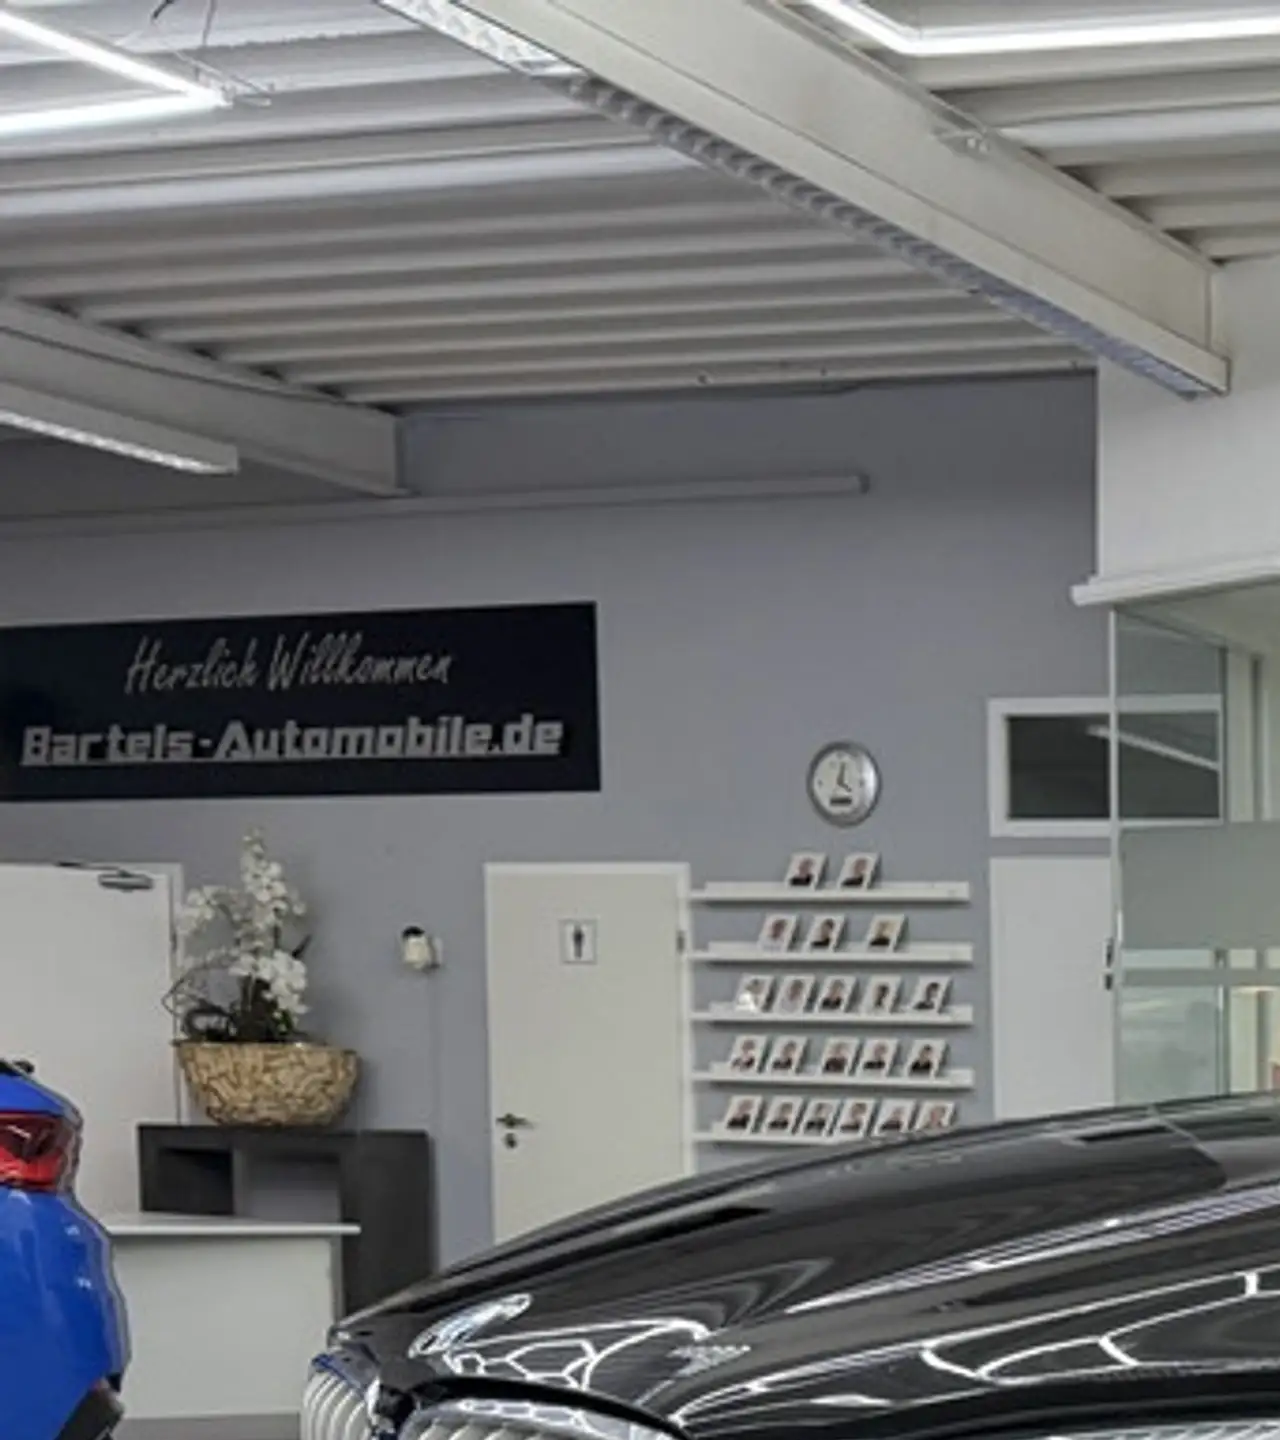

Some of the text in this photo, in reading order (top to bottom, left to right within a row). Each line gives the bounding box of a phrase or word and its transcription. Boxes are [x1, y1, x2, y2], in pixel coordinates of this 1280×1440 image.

[124, 630, 453, 694] Herzlich Willkommen
[20, 712, 564, 766] Bartels-Automobile.de
